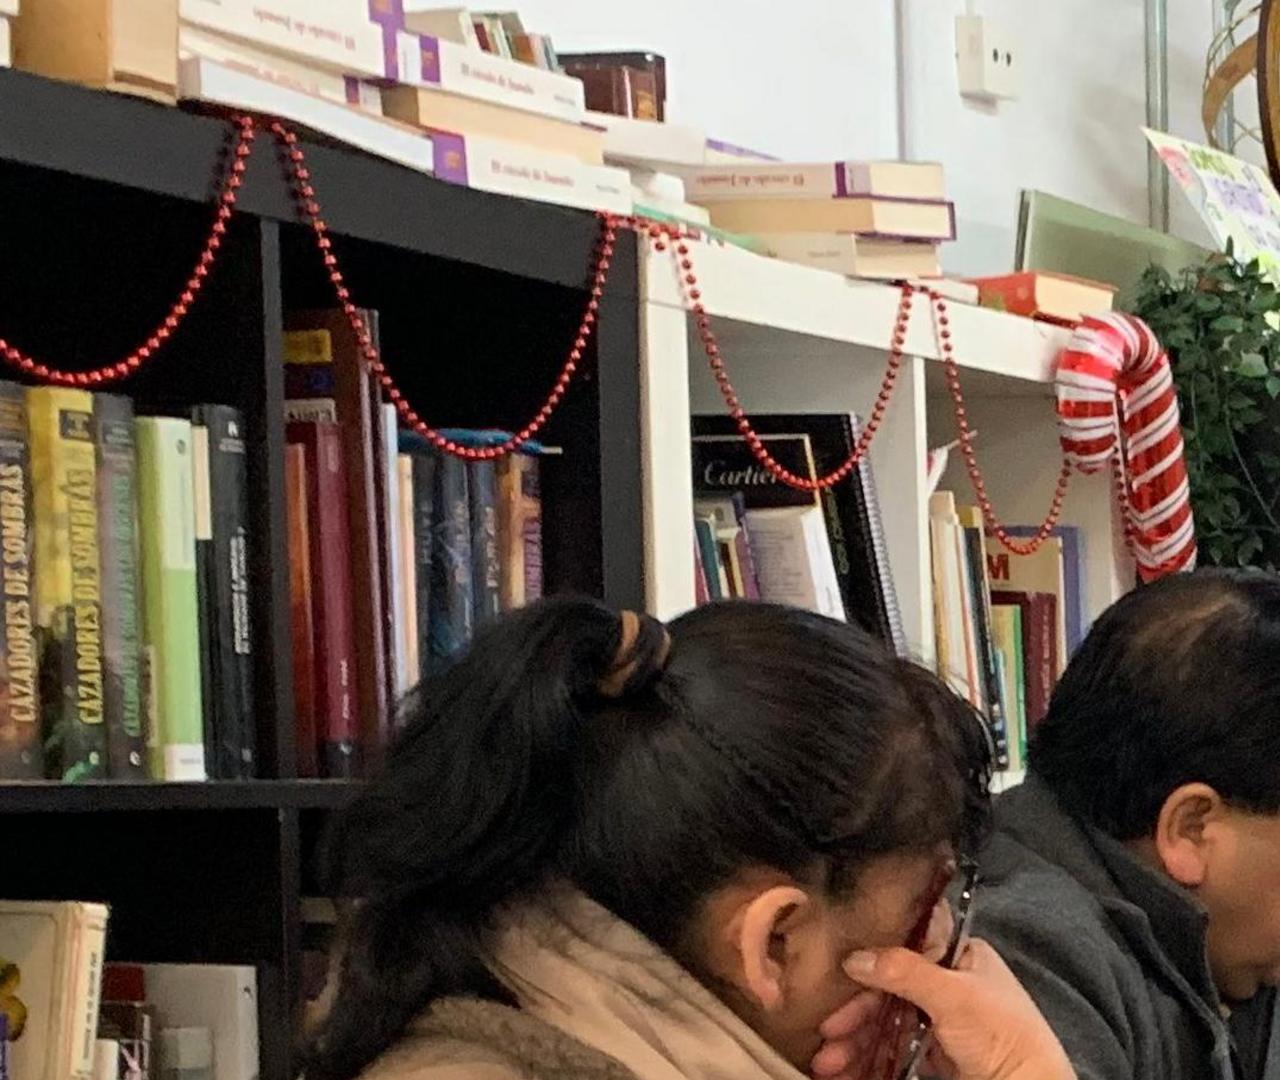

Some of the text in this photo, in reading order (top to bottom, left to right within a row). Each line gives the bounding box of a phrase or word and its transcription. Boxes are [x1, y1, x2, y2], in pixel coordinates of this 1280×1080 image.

[3, 569, 29, 596] DE
[5, 599, 37, 723] CAZADORES
[74, 605, 104, 724] CAZADORES
